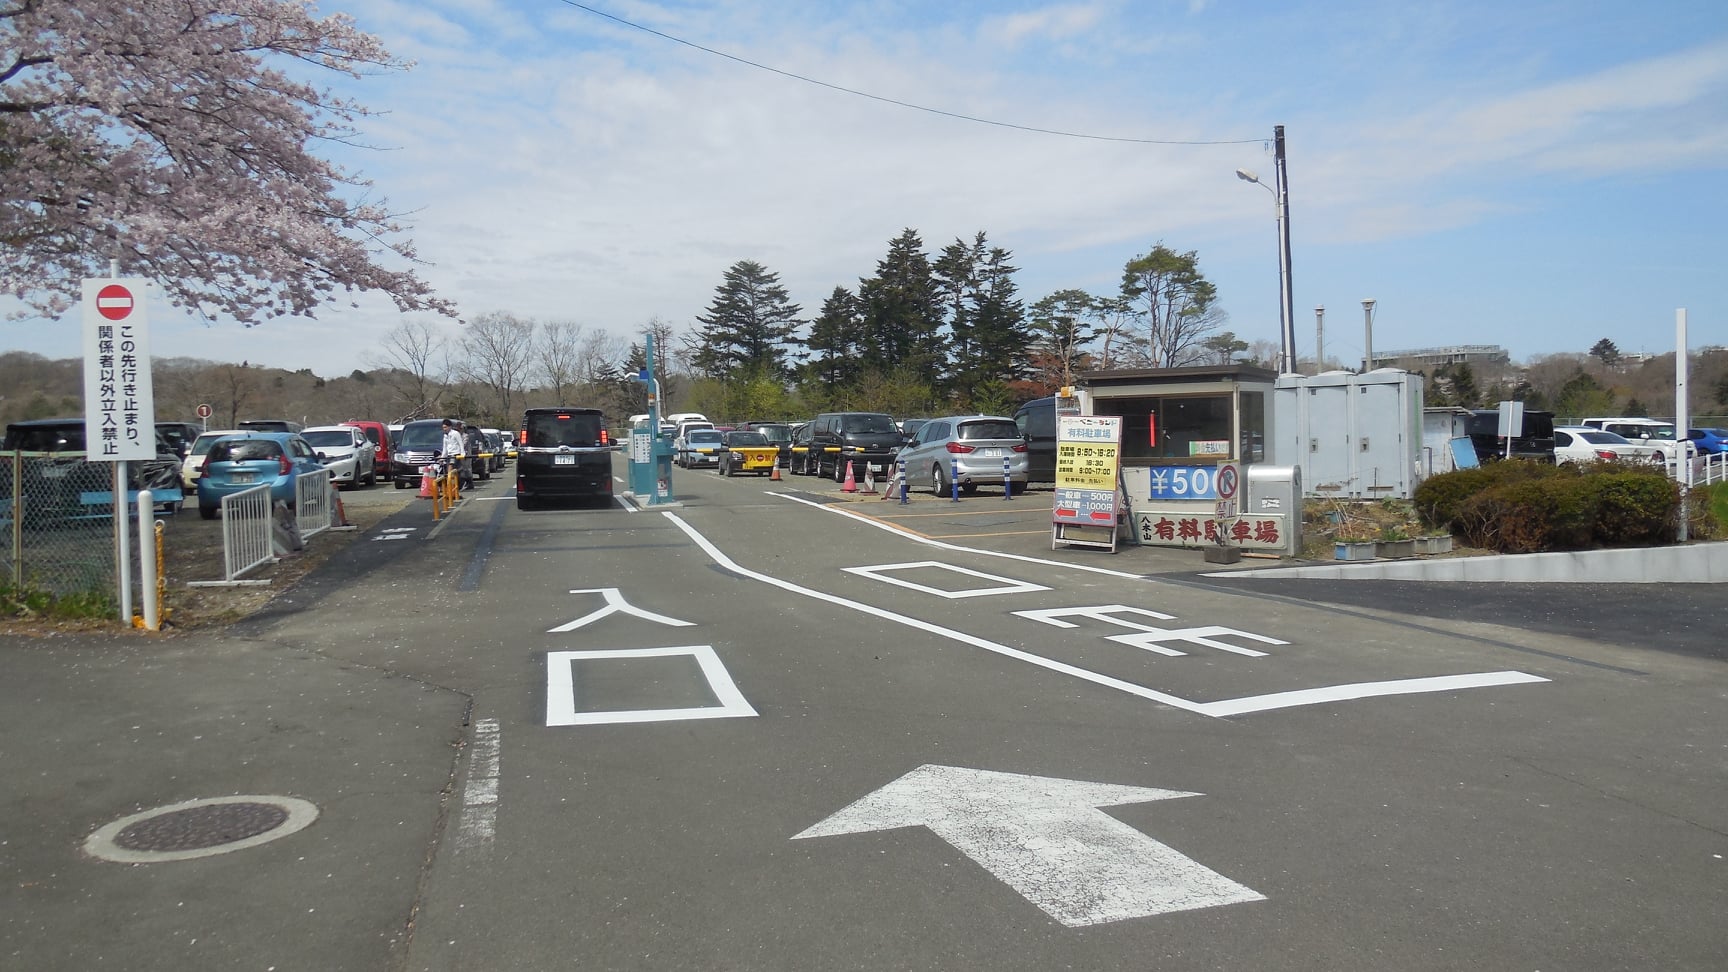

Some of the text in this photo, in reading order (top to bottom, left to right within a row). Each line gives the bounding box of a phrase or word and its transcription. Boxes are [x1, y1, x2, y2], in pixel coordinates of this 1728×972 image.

[98, 326, 119, 455] 関係者以外立入禁止
[121, 326, 139, 447] この先行き止まり、
[1068, 428, 1111, 439] 有料駐車場
[1152, 469, 1217, 495] ¥50
[1217, 500, 1236, 519] 禁止
[1140, 515, 1152, 541] 八木山
